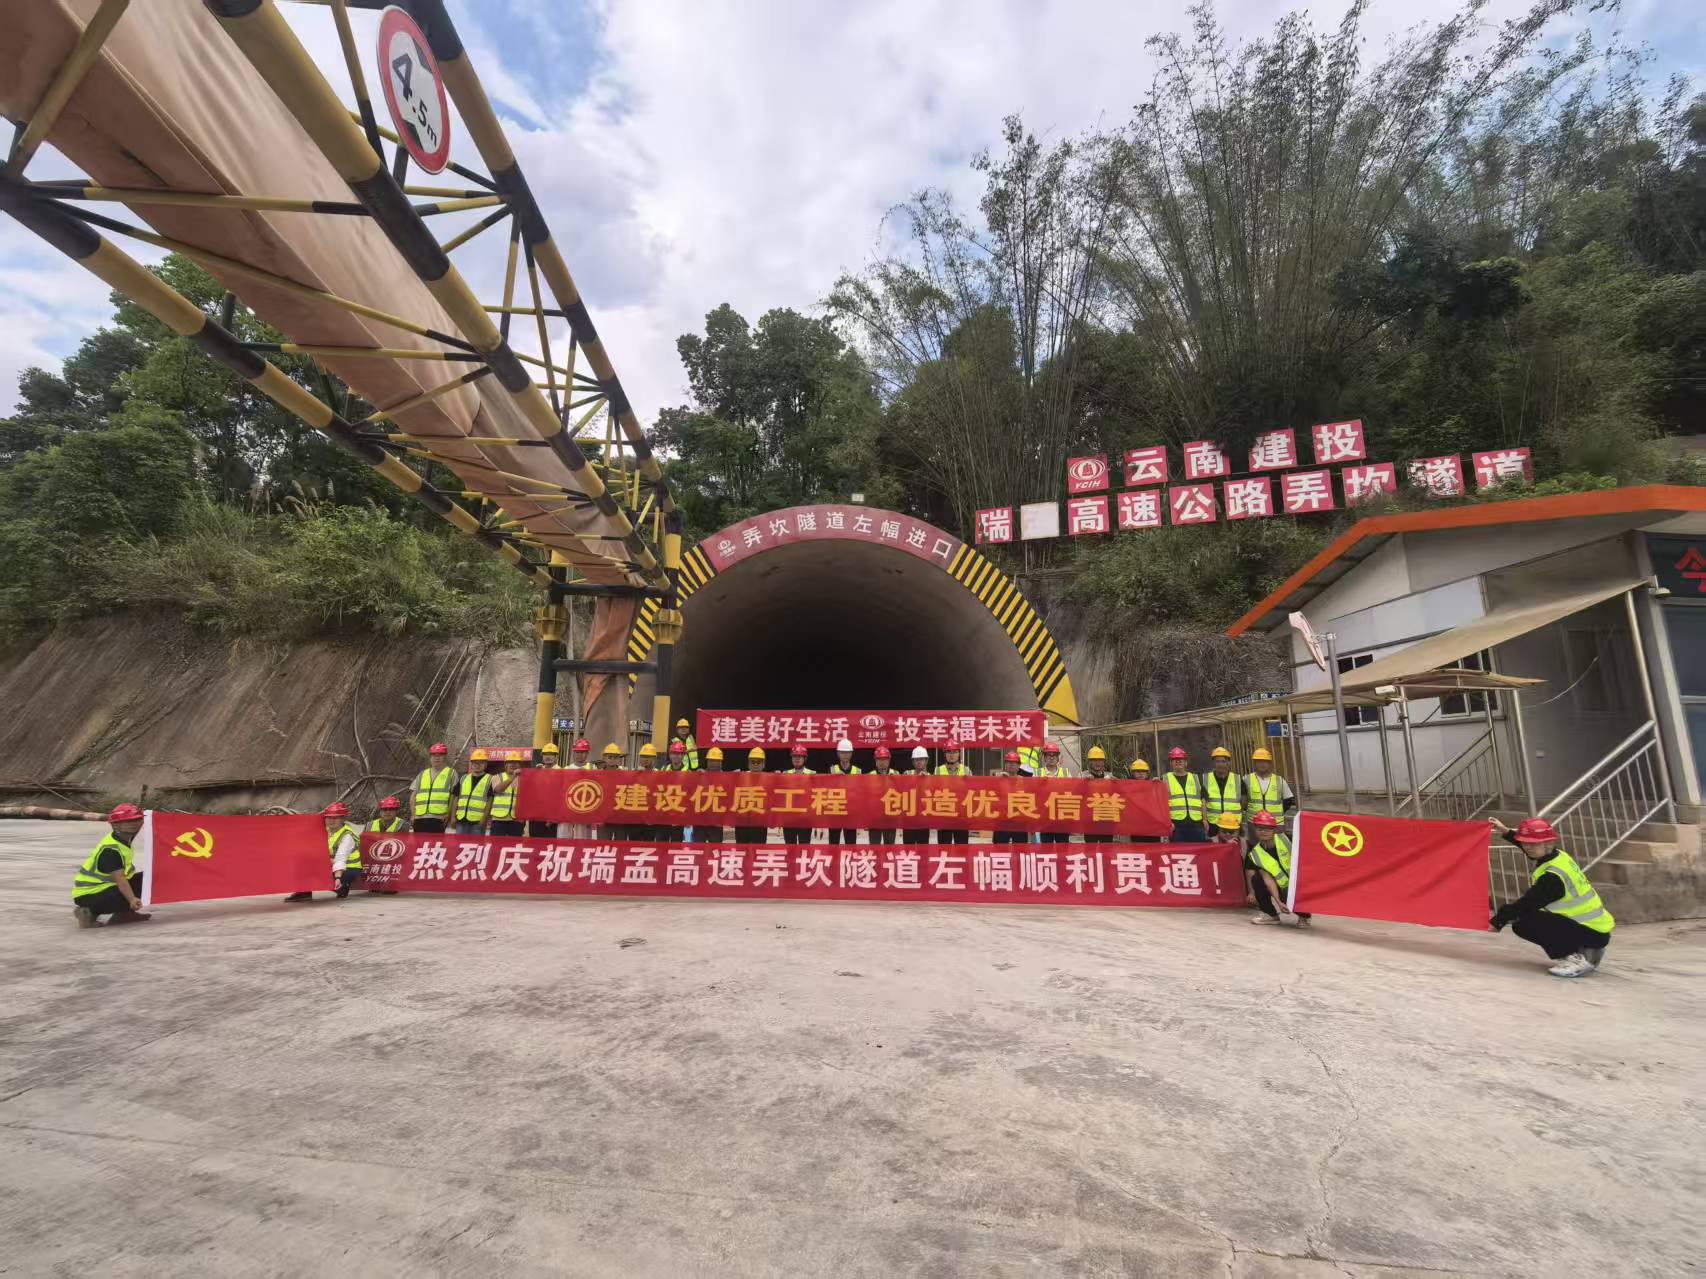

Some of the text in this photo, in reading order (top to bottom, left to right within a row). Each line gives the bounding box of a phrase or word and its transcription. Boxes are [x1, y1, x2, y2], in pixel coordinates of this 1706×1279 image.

[392, 53, 437, 147] 4.5m
[1129, 424, 1359, 482] 云南建投
[742, 511, 952, 558] 弄坎隧道左幅进口
[711, 715, 1032, 743] 建美好生活 投幸福未来
[613, 783, 1126, 823] 建设优质工程 创造优良信誉
